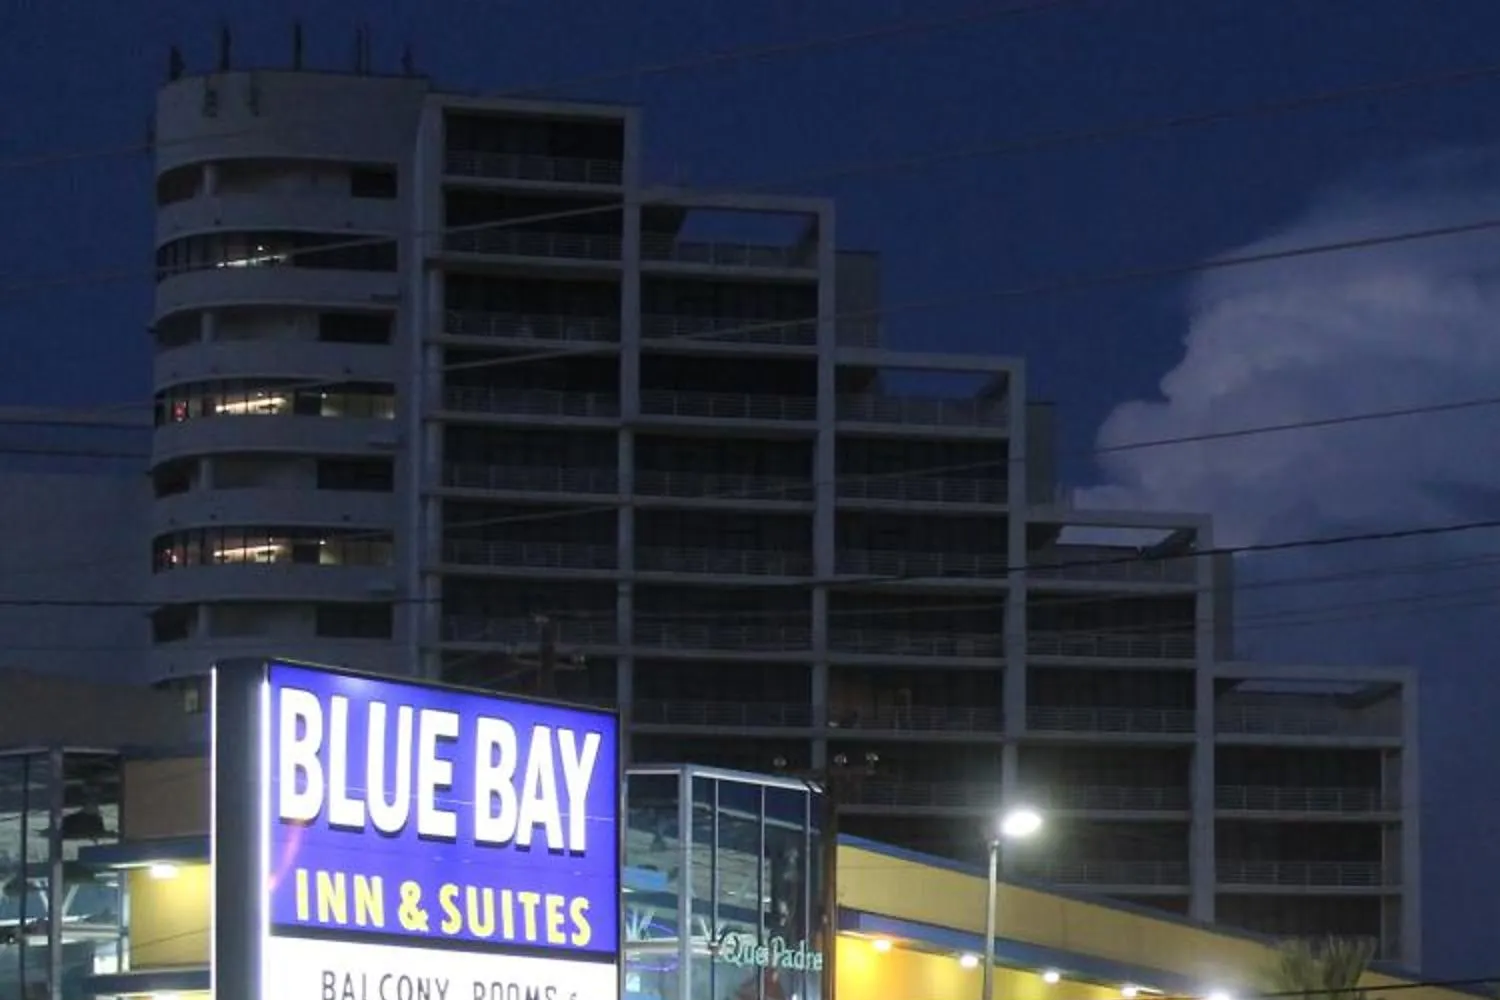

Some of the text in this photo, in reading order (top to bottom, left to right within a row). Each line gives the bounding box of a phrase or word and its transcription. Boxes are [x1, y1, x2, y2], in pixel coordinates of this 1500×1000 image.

[279, 687, 602, 856] BLUE BAY
[295, 868, 592, 947] INN & SUITES
